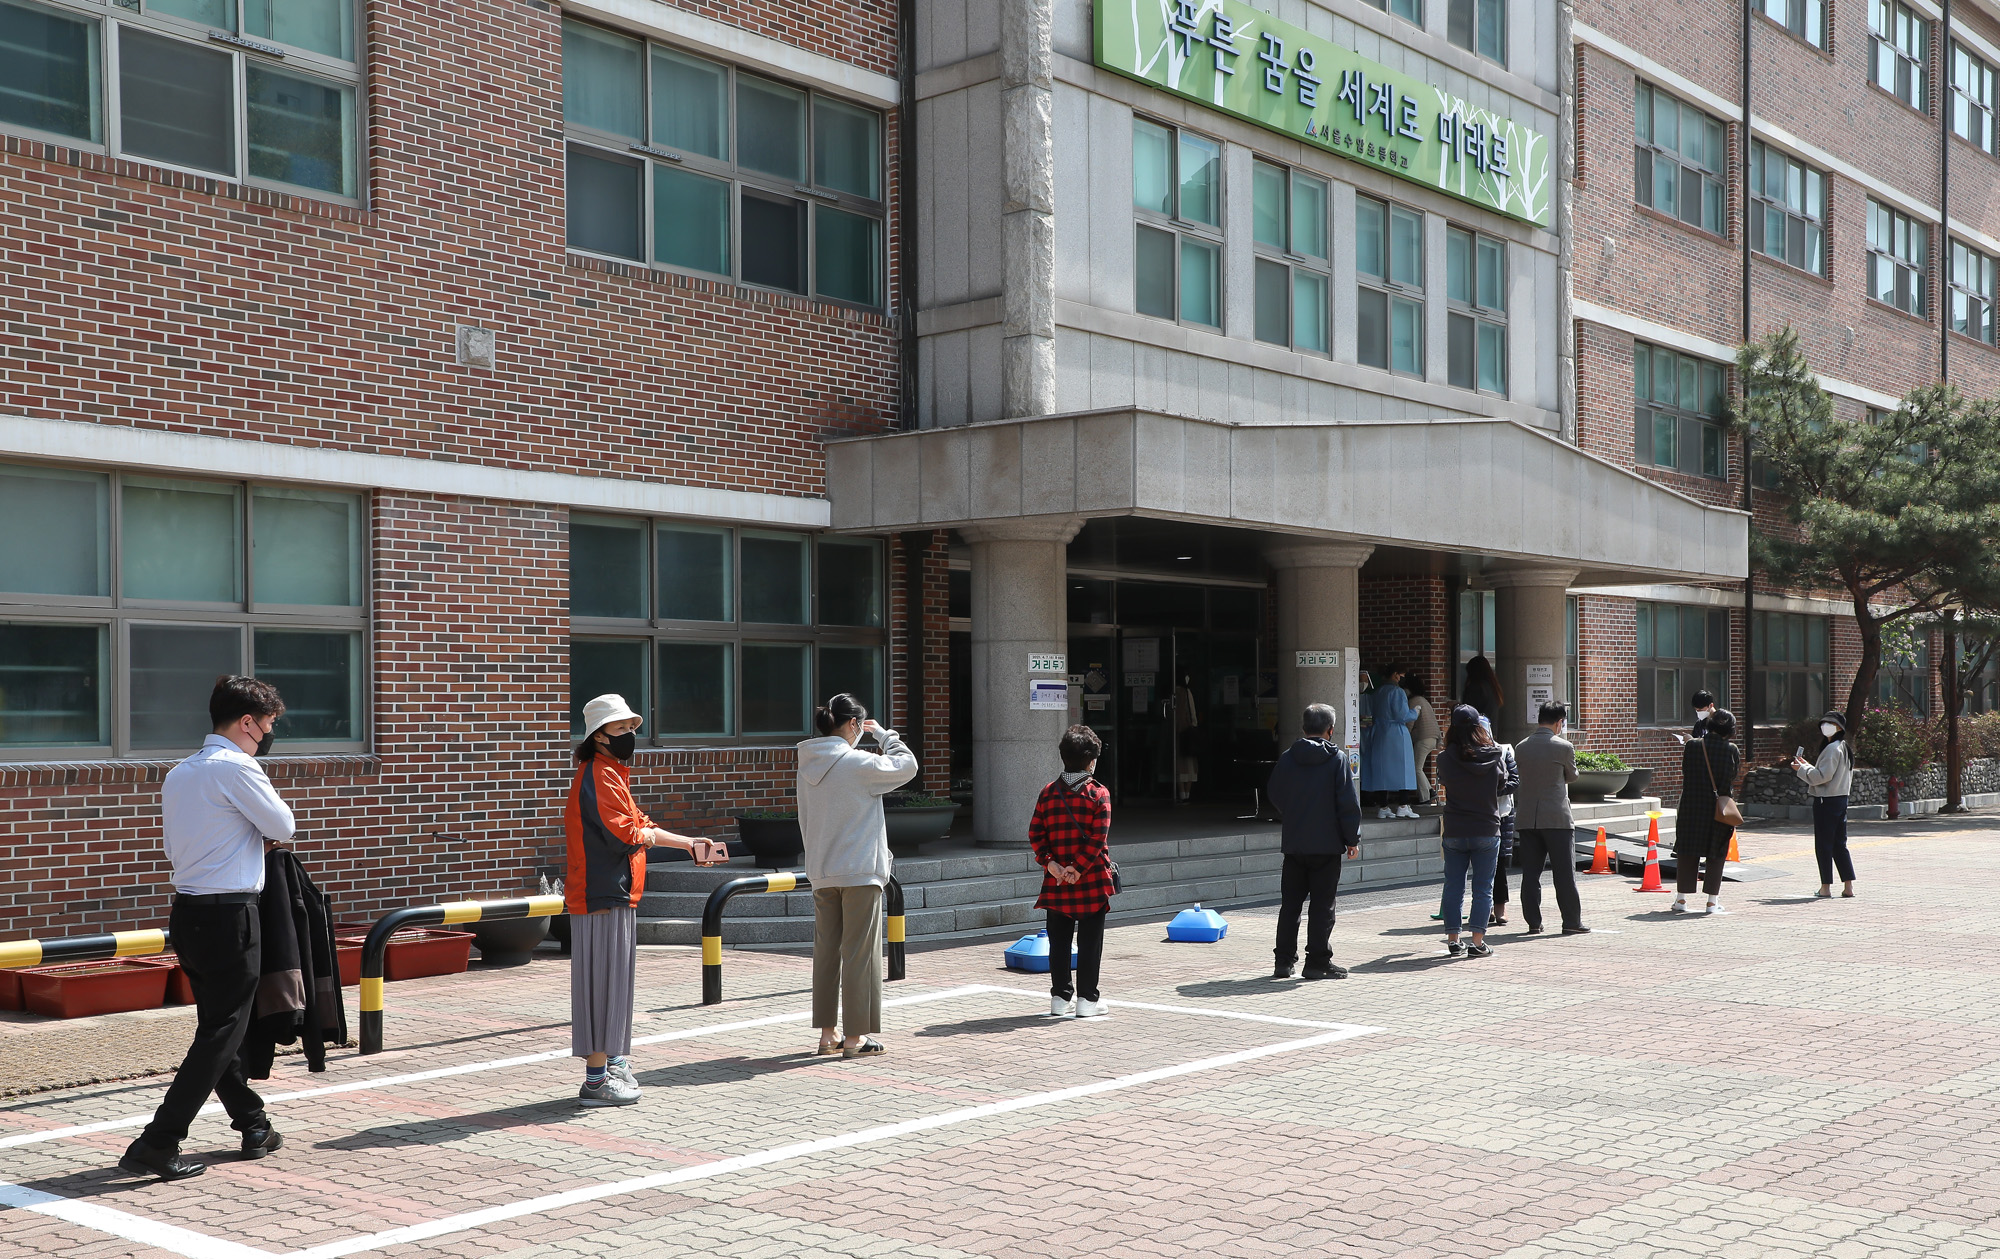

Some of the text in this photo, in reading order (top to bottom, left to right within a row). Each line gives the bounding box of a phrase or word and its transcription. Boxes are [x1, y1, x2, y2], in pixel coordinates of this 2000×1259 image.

[1169, 0, 1512, 178] 푸른 꿈을 세계로 미래로
[1299, 656, 1337, 665] 거리두기
